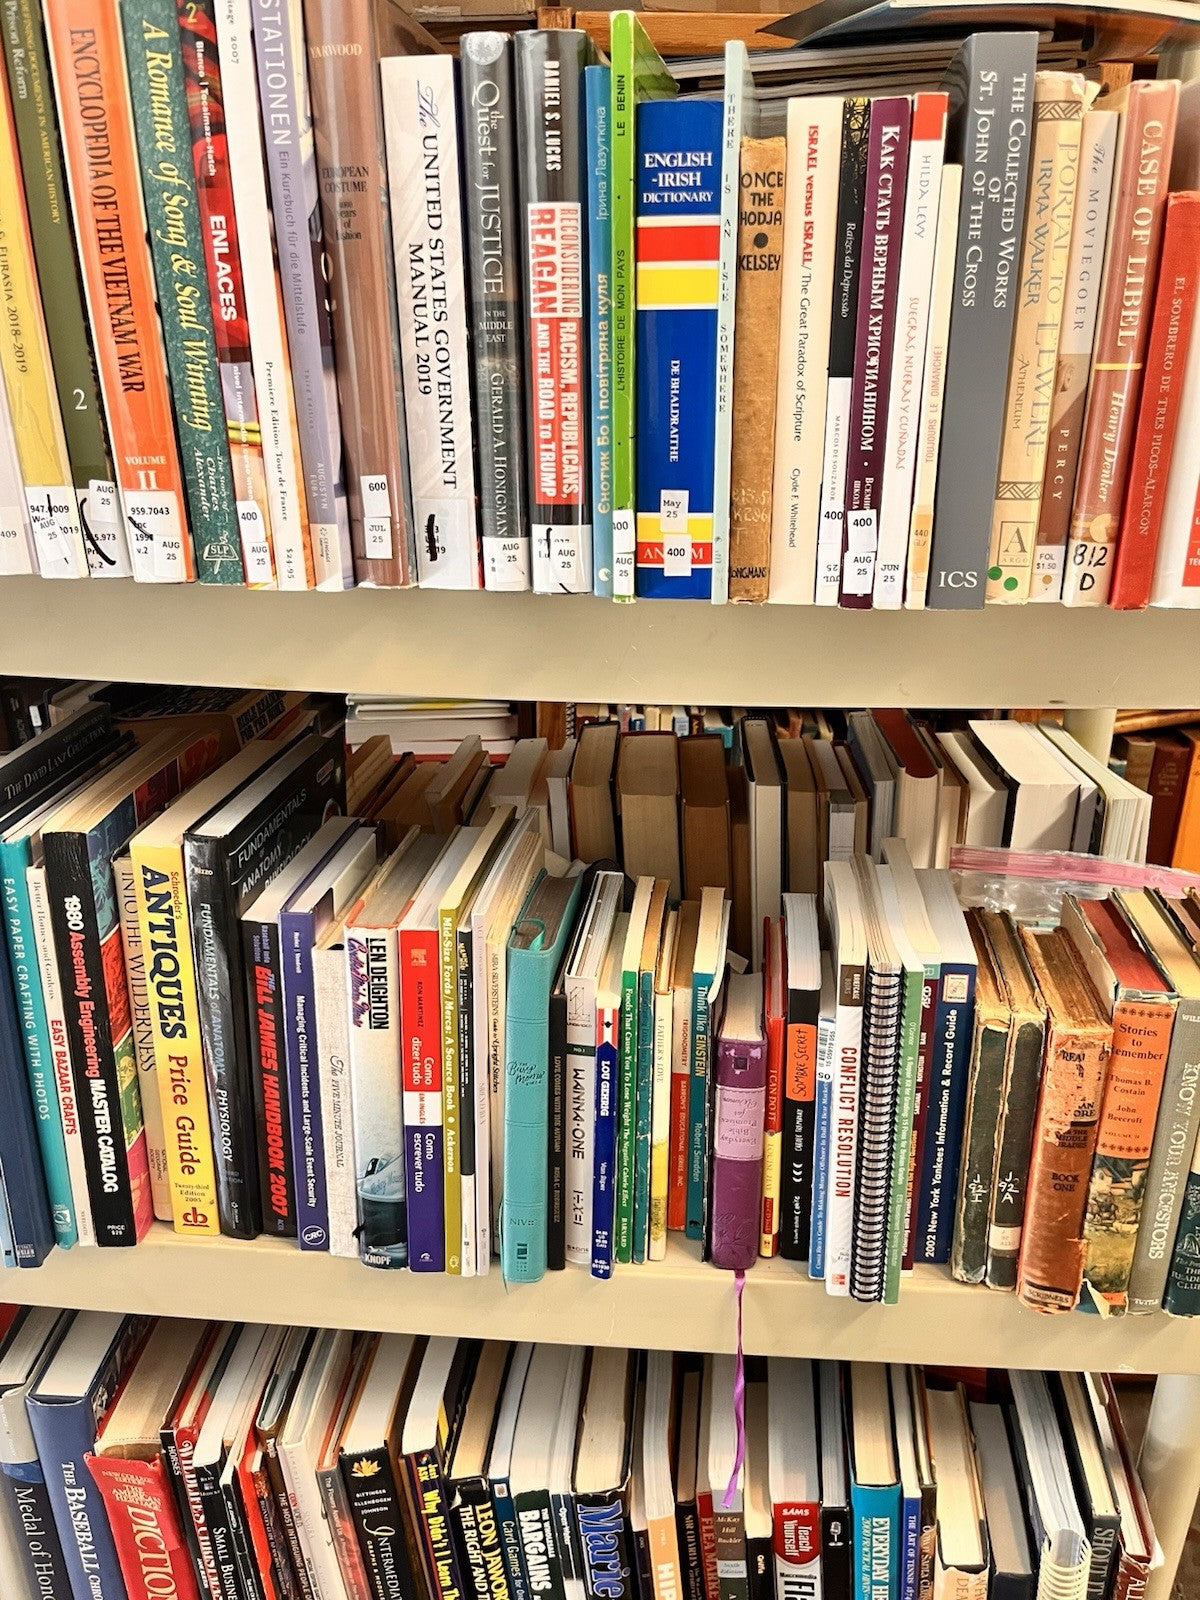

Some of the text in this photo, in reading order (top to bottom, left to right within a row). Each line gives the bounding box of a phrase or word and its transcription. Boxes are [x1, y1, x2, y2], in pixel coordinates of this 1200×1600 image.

[617, 75, 626, 136] LE BENIN
[807, 125, 818, 171] ISRAEL
[973, 107, 994, 163] JOHN
[594, 107, 608, 219] Ірина Лазуткіна
[644, 152, 712, 168] ENGLISH
[652, 172, 701, 187] -IRISH
[741, 172, 783, 188] ONCE
[643, 192, 713, 204] DICTIONARY
[750, 193, 774, 206] THE
[805, 176, 814, 217] versus
[971, 171, 986, 199] OF
[988, 177, 1001, 202] OF
[993, 74, 1027, 308] THE COLLECTED WORKS
[70, 29, 145, 394] ENCYCLOPEDIA OF THE VIETNAM WAR
[142, 20, 214, 432] A Romance of Song & Soul Winning
[740, 210, 782, 226] HODJA
[968, 201, 983, 240] THE
[1117, 120, 1164, 347] CASE OF LIBEL
[210, 214, 238, 322] ENLACES
[530, 208, 557, 314] REAGAN
[560, 208, 580, 314] RECONSIDERING
[738, 254, 781, 271] KELSEY
[801, 274, 812, 294] The
[962, 246, 982, 308] CROSS
[416, 80, 458, 489] The UNITED STATES GOVERNMENT
[598, 273, 611, 316] куля
[408, 243, 432, 395] MANUAL 2019
[616, 250, 626, 391] L'HISTOIRE DE MON PAYS
[799, 298, 810, 329] Great
[597, 321, 611, 411] повітряна
[797, 333, 808, 376] Paradox
[797, 380, 805, 391] of
[536, 323, 557, 498] AND THE ROAD TO TRUMP
[559, 322, 580, 499] RACISM, REPUBLICANS,
[793, 394, 806, 441] Scripture
[597, 425, 610, 445] Бо
[1097, 391, 1127, 503] Henry Denker
[124, 456, 167, 465] VOLUME
[137, 470, 156, 490] II
[597, 450, 611, 513] Єнотик
[1053, 429, 1070, 500] PERCY
[369, 482, 386, 492] 600
[663, 499, 681, 509] May
[131, 507, 170, 516] 959.7043
[667, 548, 685, 557] 400
[938, 571, 978, 588] ICS
[171, 871, 183, 919] Schroeder's
[142, 865, 187, 1039] ANTIQUES
[3, 879, 50, 1121] EASY PAPER CRAFTING WITH PHOTOS
[370, 938, 389, 1029] LEN DEIGHTON
[296, 995, 305, 1033] Managing
[695, 986, 708, 1077] Think like EINSTEIN
[1119, 1023, 1158, 1037] Stories
[64, 895, 119, 1193] 1980 Assembly Engineering MASTER CATALOG
[299, 1035, 307, 1062] Critical
[412, 1037, 422, 1085] dizer tudo
[1132, 1038, 1142, 1047] to
[51, 1020, 77, 1135] EASY BAZAAR CRAFTS
[255, 965, 288, 1217] BILL JAMES HANDBOOK 2007
[300, 1062, 310, 1098] Incidents
[424, 1057, 434, 1085] Como
[601, 1061, 610, 1116] LOU GEHRIG
[168, 1055, 195, 1175] Price Guide
[303, 1112, 314, 1156] Large-Scale
[835, 1047, 857, 1197] CONFLICT RESOLUTION
[925, 1009, 957, 1257] 2002 New York Yankees Information & Record Guide
[304, 1158, 314, 1177] Event
[414, 1133, 426, 1192] escrever tudo
[425, 1133, 435, 1160] Como
[306, 1178, 316, 1207] Security
[1052, 1173, 1079, 1182] BOOK
[1054, 1183, 1075, 1191] ONE
[303, 1230, 323, 1242] CRC
[167, 1446, 181, 1475] HORSES
[14, 1487, 52, 1557] Medal of
[61, 1462, 99, 1573] THE BASEBALL
[474, 1503, 499, 1545] LEON
[784, 1520, 799, 1556] Yourself
[797, 1525, 812, 1552] Teach
[213, 1528, 228, 1562] SMALL
[459, 1505, 489, 1591] THE RIGHT AND
[502, 1521, 523, 1588] Card Games for
[519, 1509, 552, 1591] BARGAINS
[576, 1500, 631, 1599] Marie
[871, 1517, 890, 1581] EVERYDAY
[907, 1515, 917, 1584] THE ART OF TENNIS
